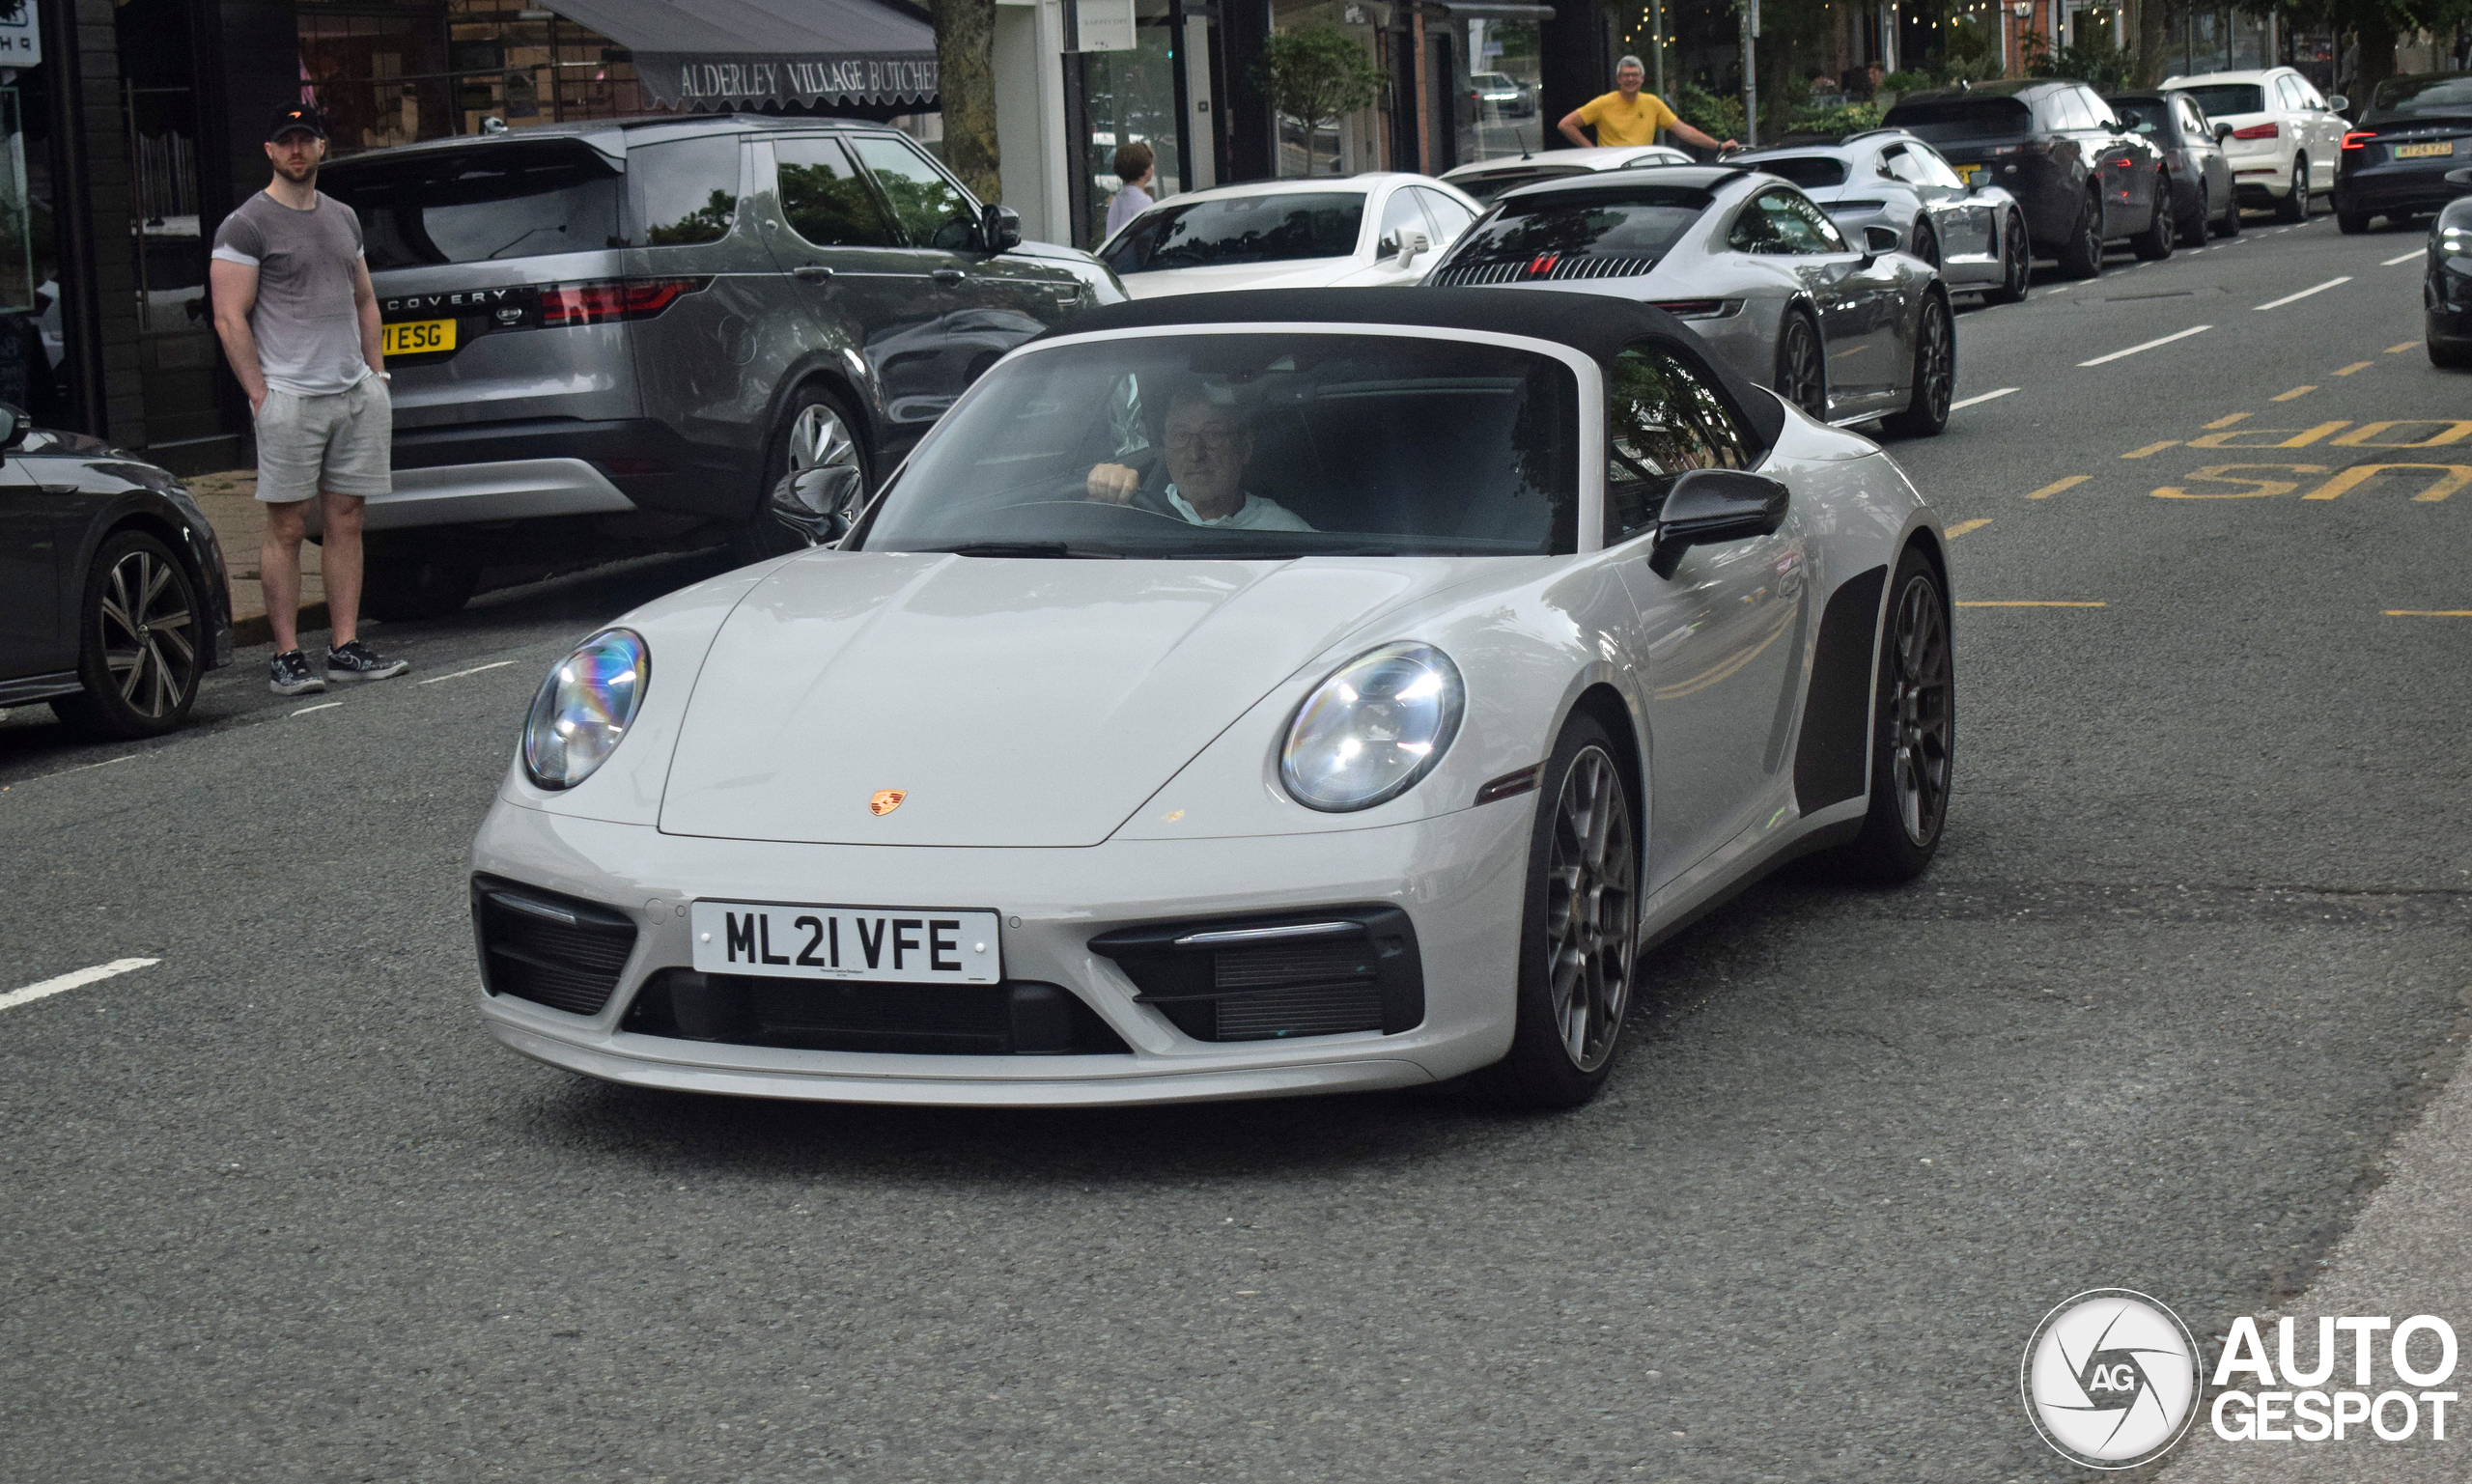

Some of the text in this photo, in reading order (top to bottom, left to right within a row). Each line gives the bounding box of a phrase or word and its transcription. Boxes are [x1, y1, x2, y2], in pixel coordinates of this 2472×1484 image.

[682, 63, 777, 97] ALDERLEY
[787, 60, 866, 94] VILLAGE
[398, 323, 441, 350] ESG
[725, 911, 962, 971] ML21 VFE
